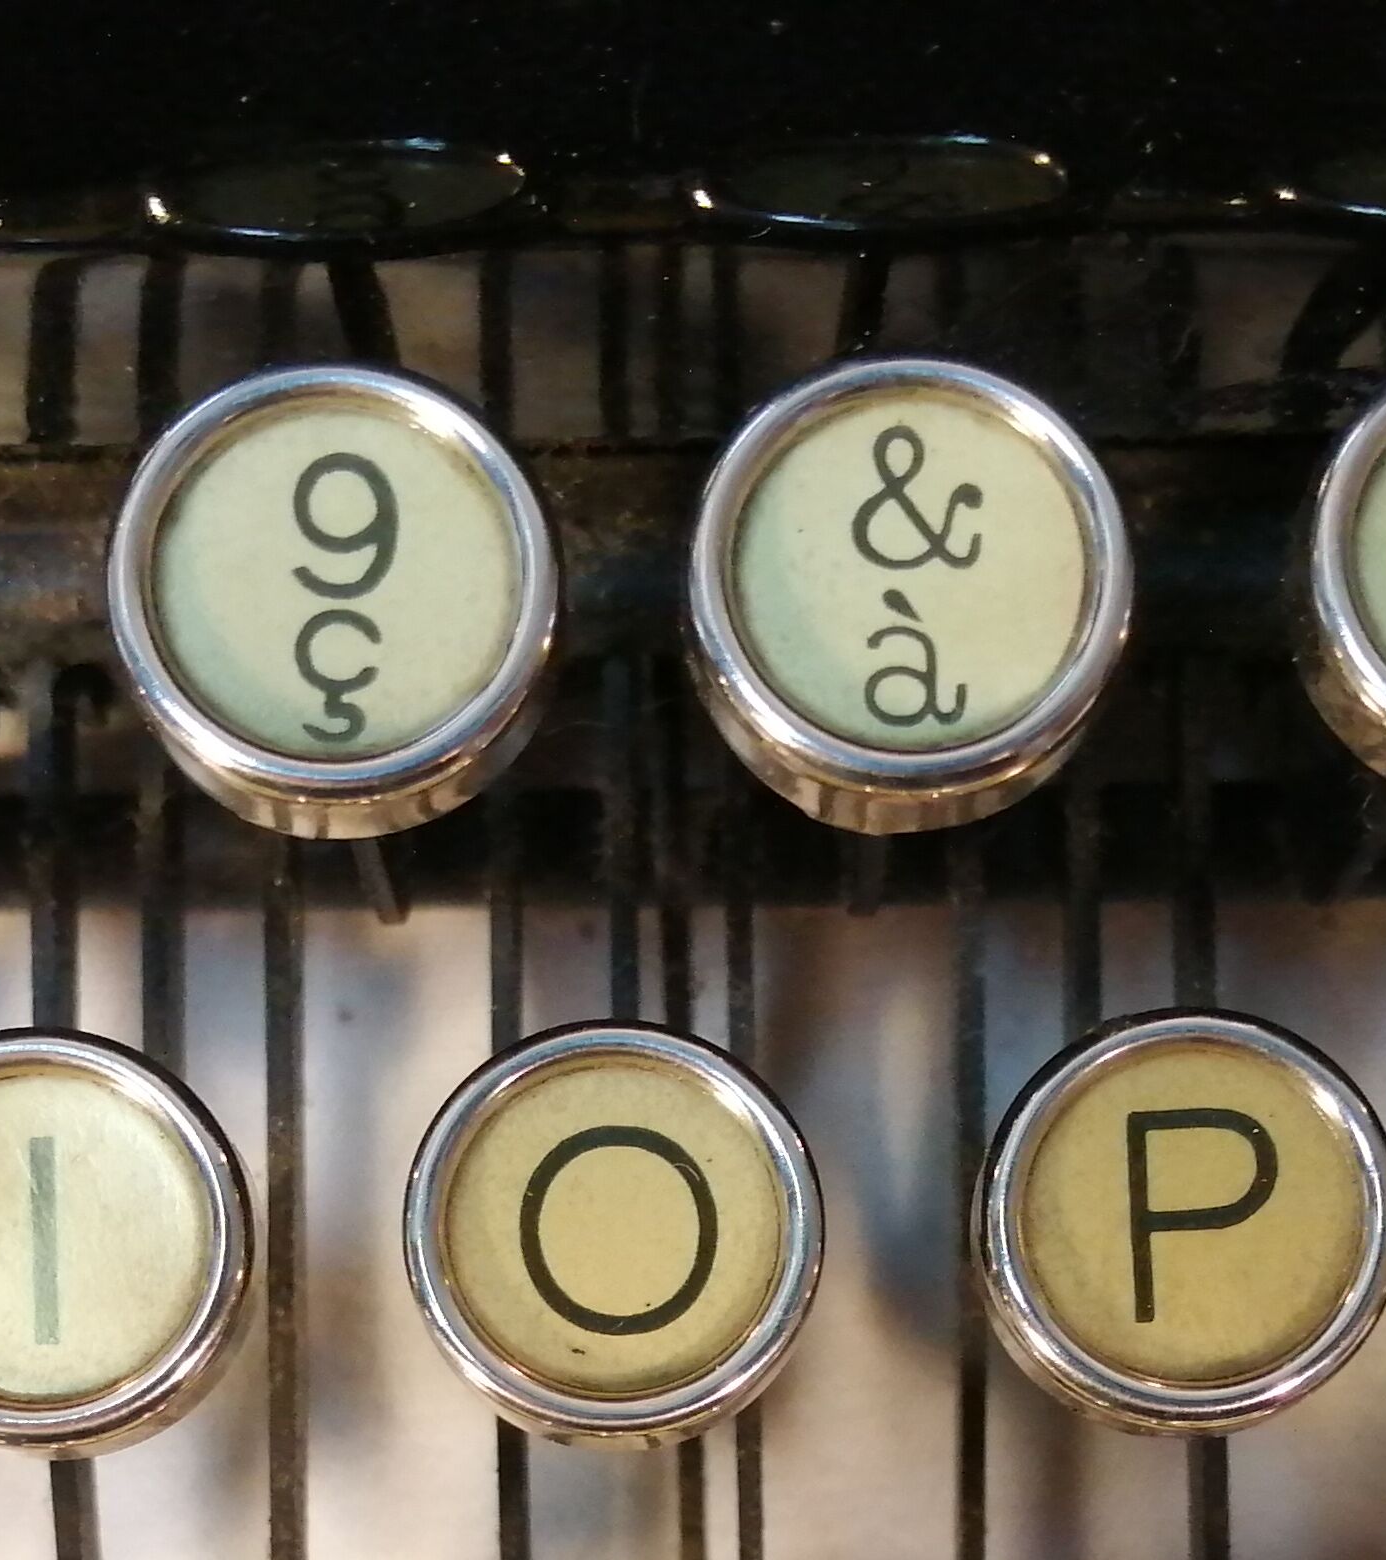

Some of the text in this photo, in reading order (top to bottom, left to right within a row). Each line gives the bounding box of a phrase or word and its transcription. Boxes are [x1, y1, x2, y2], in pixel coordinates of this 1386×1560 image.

[292, 452, 399, 600] 9
[850, 424, 983, 571] &
[294, 608, 383, 744] ç
[863, 588, 967, 728] à
[26, 1135, 60, 1346] I
[519, 1125, 719, 1337] O
[1126, 1107, 1279, 1324] P
